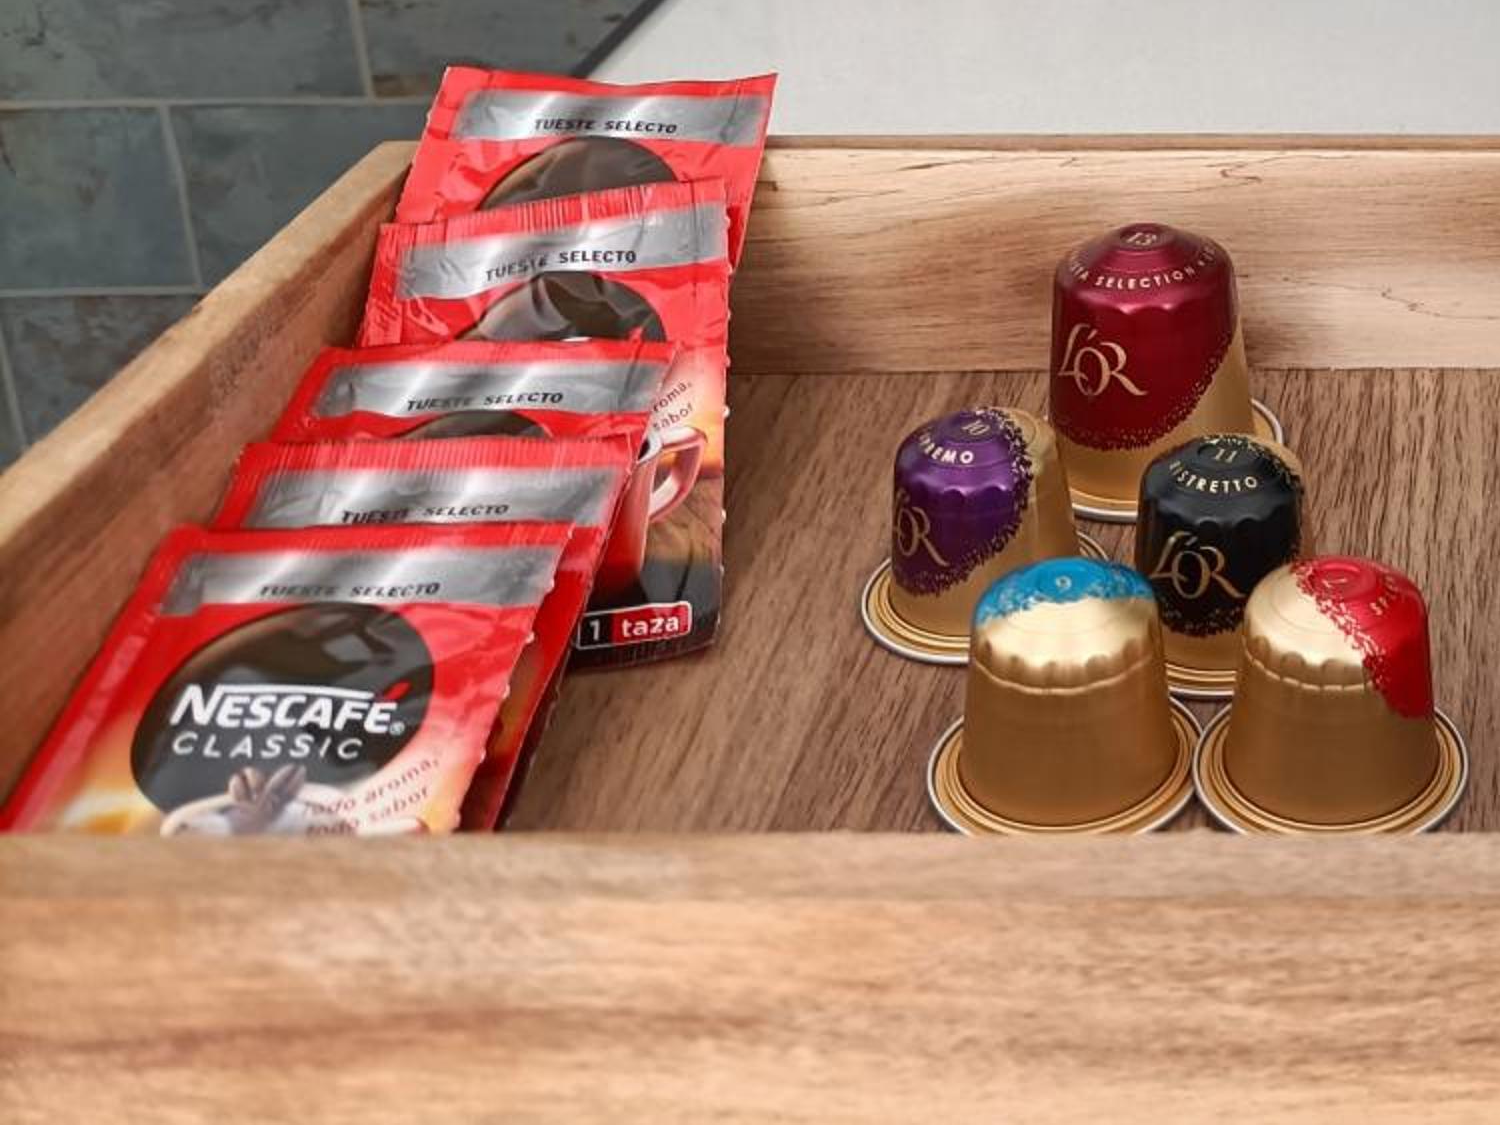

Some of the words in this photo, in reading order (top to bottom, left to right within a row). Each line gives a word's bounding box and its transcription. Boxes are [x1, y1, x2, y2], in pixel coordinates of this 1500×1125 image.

[603, 119, 678, 134] SELECTO
[558, 250, 637, 264] SELECTO
[1094, 265, 1196, 290] SELECTION
[1058, 322, 1148, 397] L'OR
[483, 391, 564, 406] SELECTO
[653, 381, 693, 413] roma,
[421, 504, 510, 517] SELECTO
[1150, 530, 1247, 600] L'OR
[350, 582, 441, 597] SELECTO
[589, 619, 601, 641] 1
[621, 614, 680, 639] taza
[171, 730, 364, 761] CLASSIC
